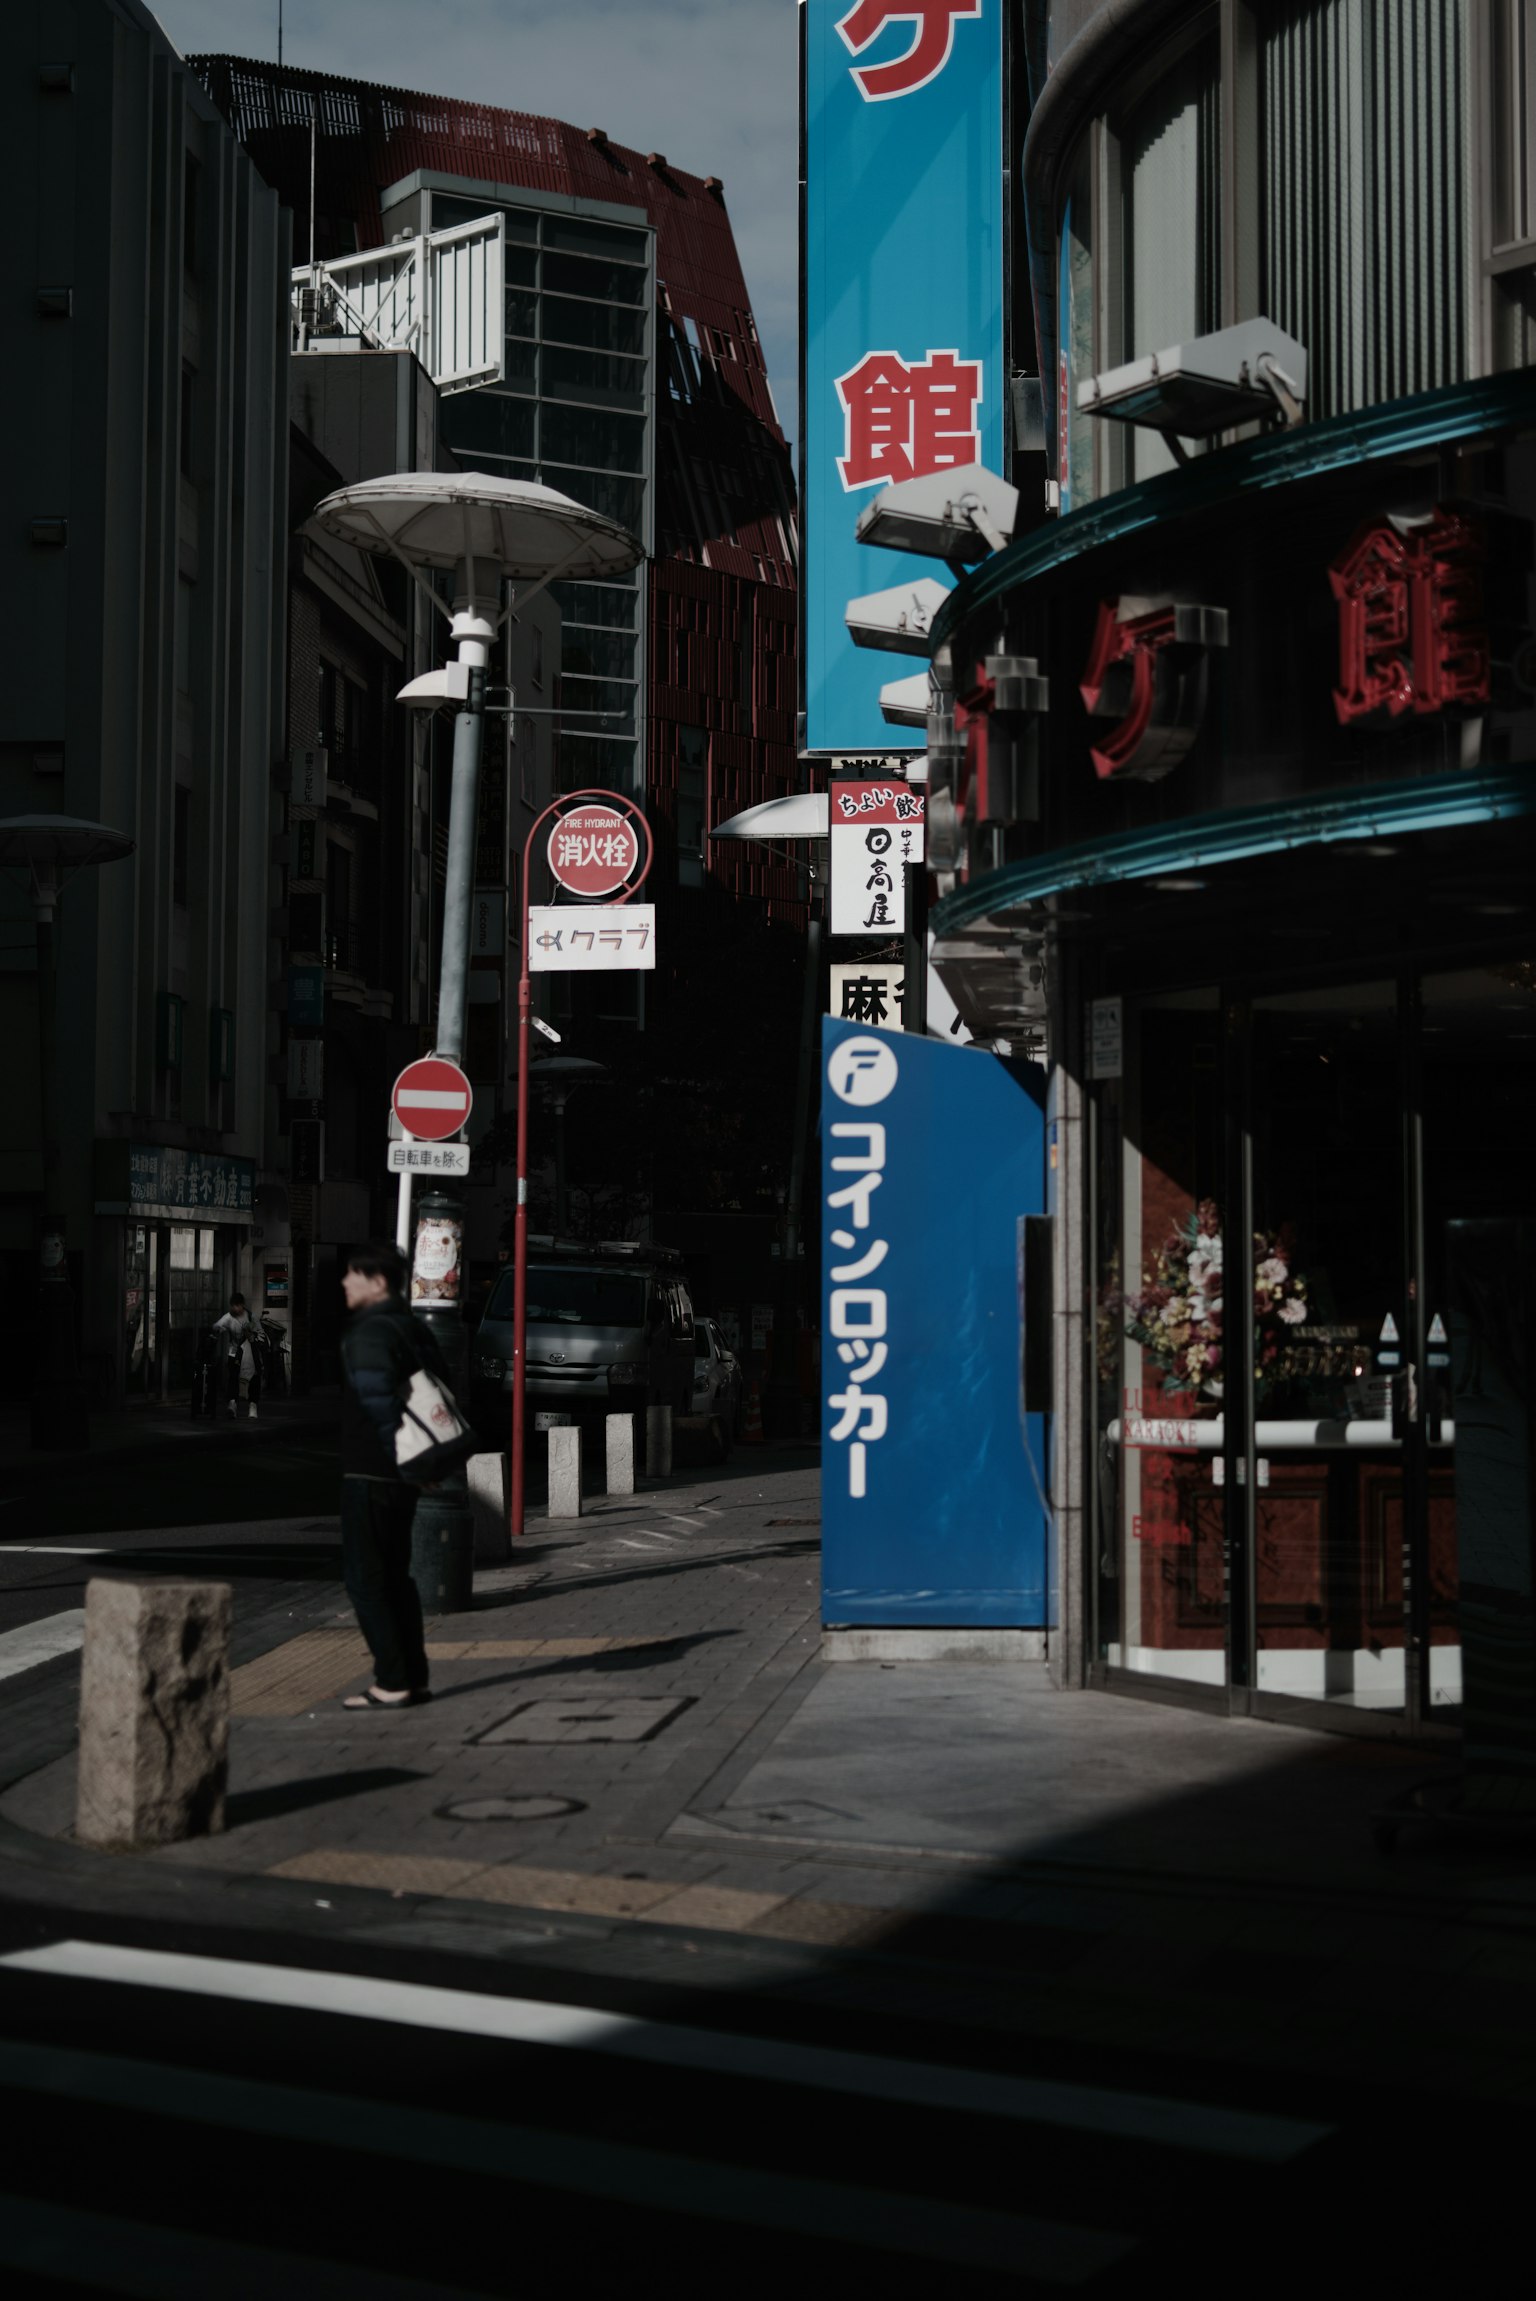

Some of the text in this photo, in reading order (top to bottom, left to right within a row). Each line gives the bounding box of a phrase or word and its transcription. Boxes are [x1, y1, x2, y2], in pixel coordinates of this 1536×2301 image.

[838, 788, 924, 820] ちょい飲
[564, 818, 622, 829] FIRE HYDRANT
[557, 833, 630, 868] 消火栓
[479, 902, 489, 947] docomo
[841, 975, 905, 1030] 麻
[393, 1149, 465, 1168] 自転車を除く
[827, 1122, 890, 1499] コインロッカー
[1123, 1419, 1198, 1443] KARAOKE
